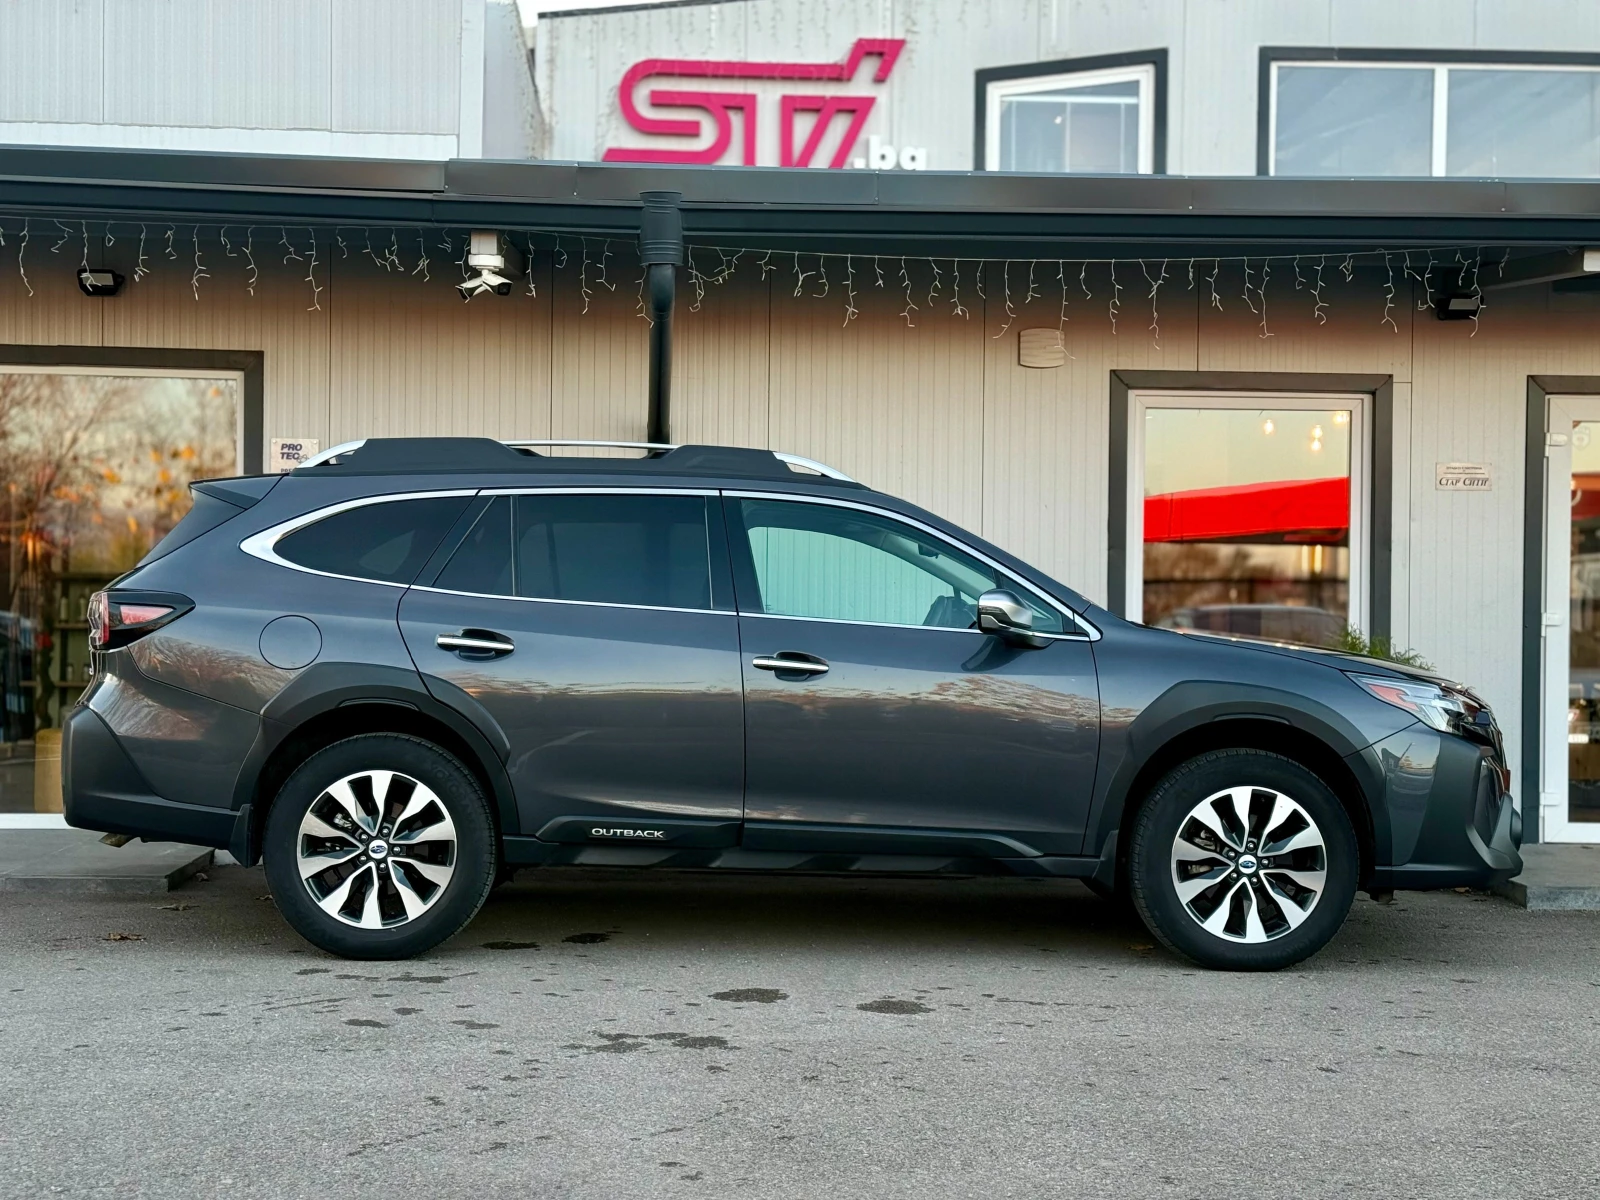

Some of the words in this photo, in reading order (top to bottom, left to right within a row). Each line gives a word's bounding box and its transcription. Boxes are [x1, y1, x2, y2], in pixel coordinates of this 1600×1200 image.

[281, 443, 303, 452] PRO
[280, 452, 301, 460] TEC
[591, 828, 664, 838] OUTBACK
